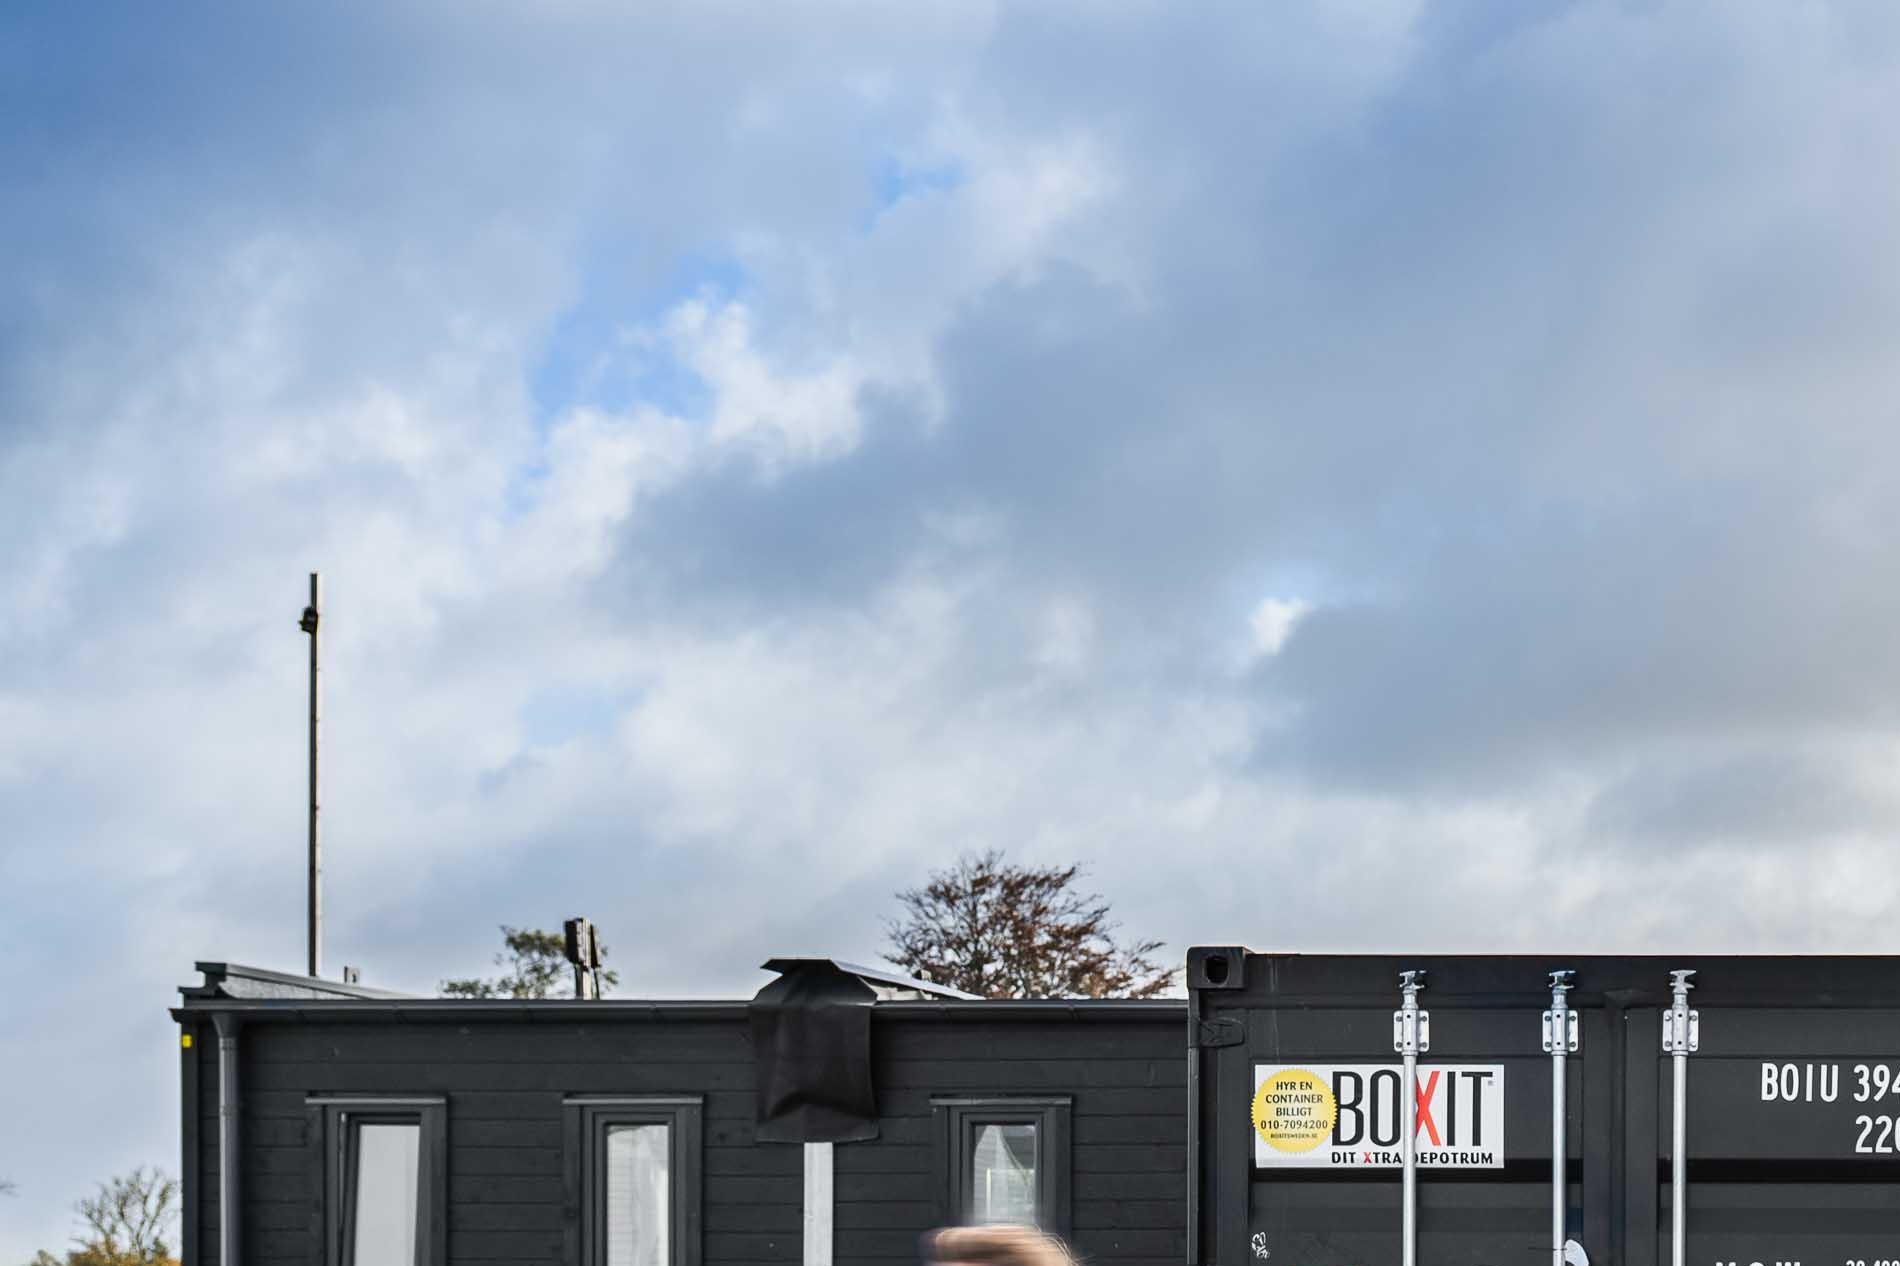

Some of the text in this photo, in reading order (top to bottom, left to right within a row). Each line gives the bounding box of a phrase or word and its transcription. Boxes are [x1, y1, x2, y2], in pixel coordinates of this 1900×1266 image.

[1276, 1081, 1313, 1091] HYR EN
[1761, 1063, 1839, 1101] BOIU
[1265, 1094, 1324, 1104] CONTAINER
[1276, 1107, 1312, 1117] BILLIGT
[1332, 1069, 1493, 1147] BOXIT
[1260, 1120, 1329, 1130] 010-7094200
[1332, 1152, 1356, 1164] DIT
[1363, 1152, 1402, 1164] XTRA
